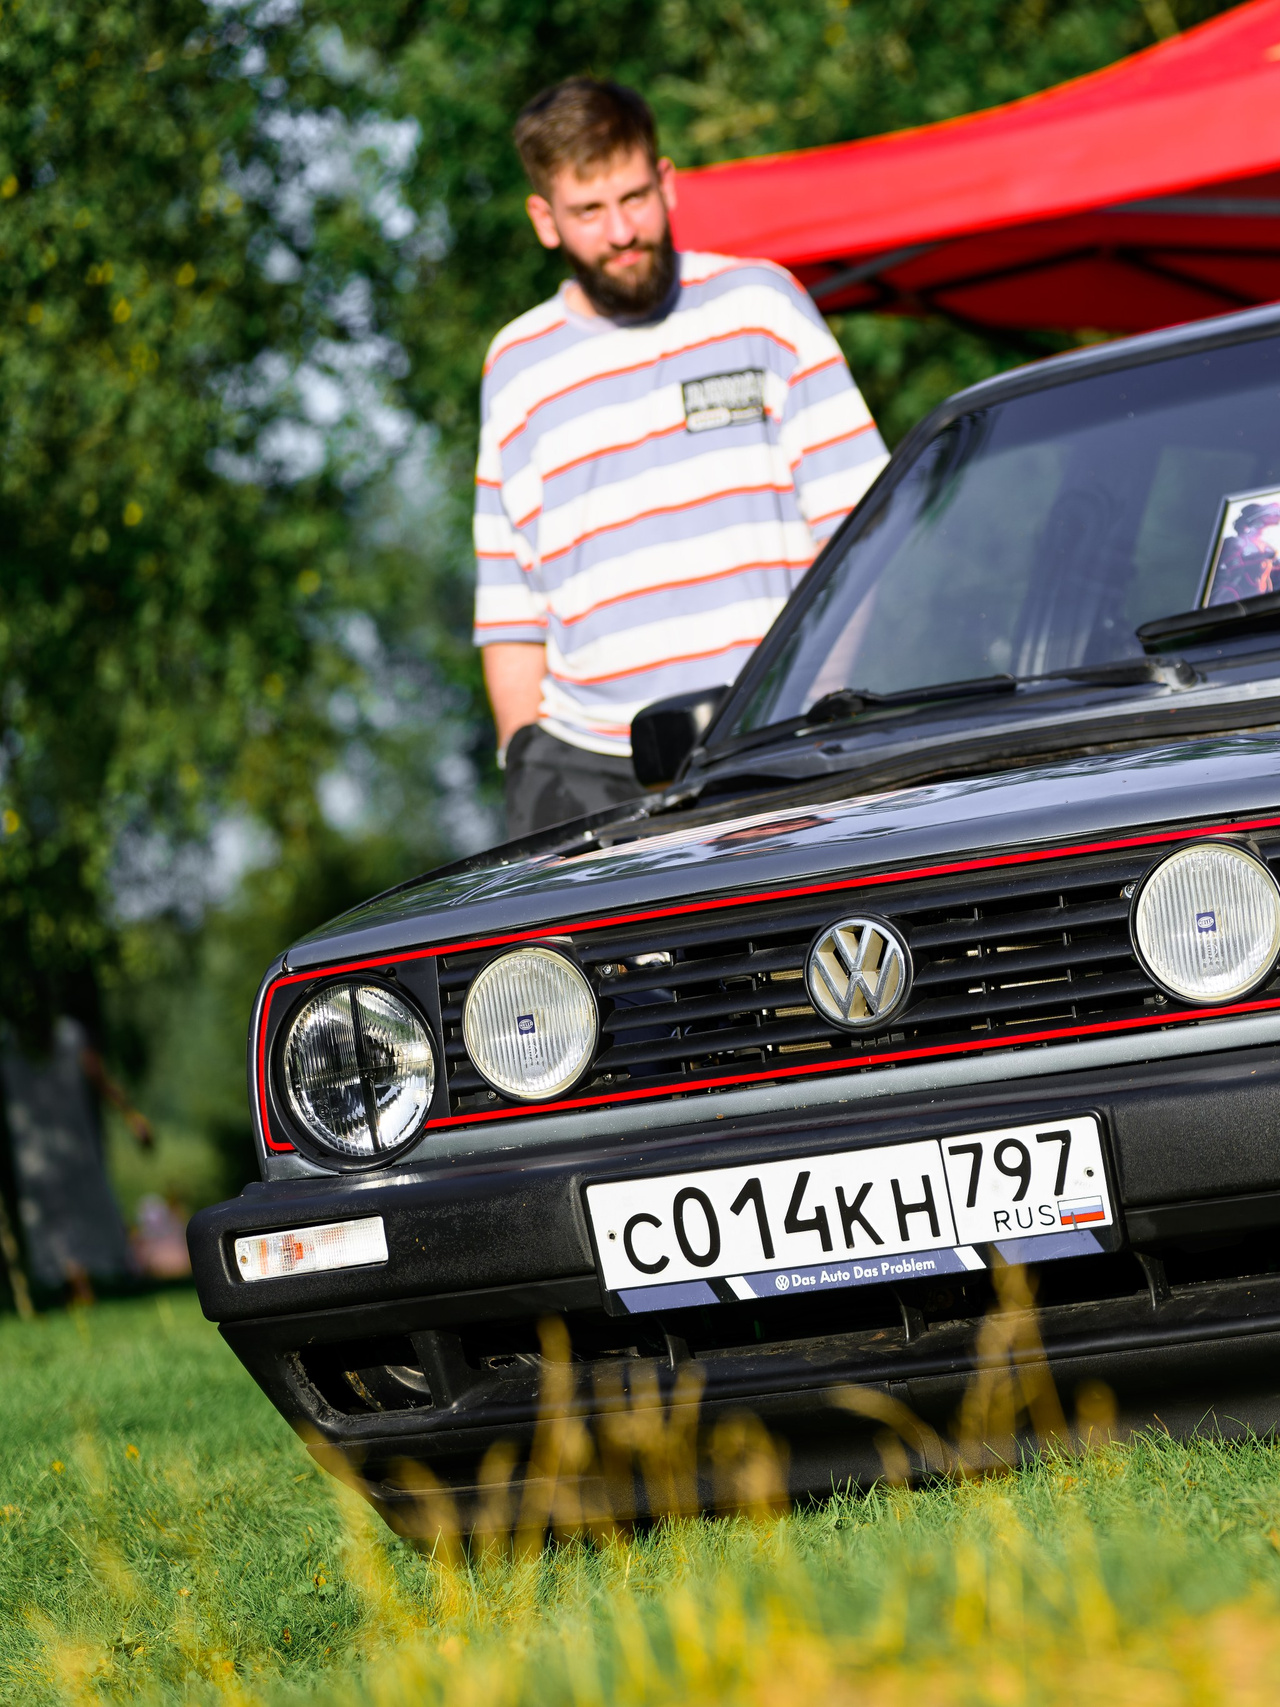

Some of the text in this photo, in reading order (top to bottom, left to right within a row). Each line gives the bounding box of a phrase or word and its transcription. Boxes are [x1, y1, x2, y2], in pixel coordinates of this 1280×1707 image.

[948, 1130, 1071, 1208] 797
[994, 1204, 1056, 1233] RUS
[791, 1274, 816, 1287] Das
[820, 1269, 850, 1284] Auto
[853, 1266, 878, 1280] Das
[881, 1257, 935, 1276] Problem
